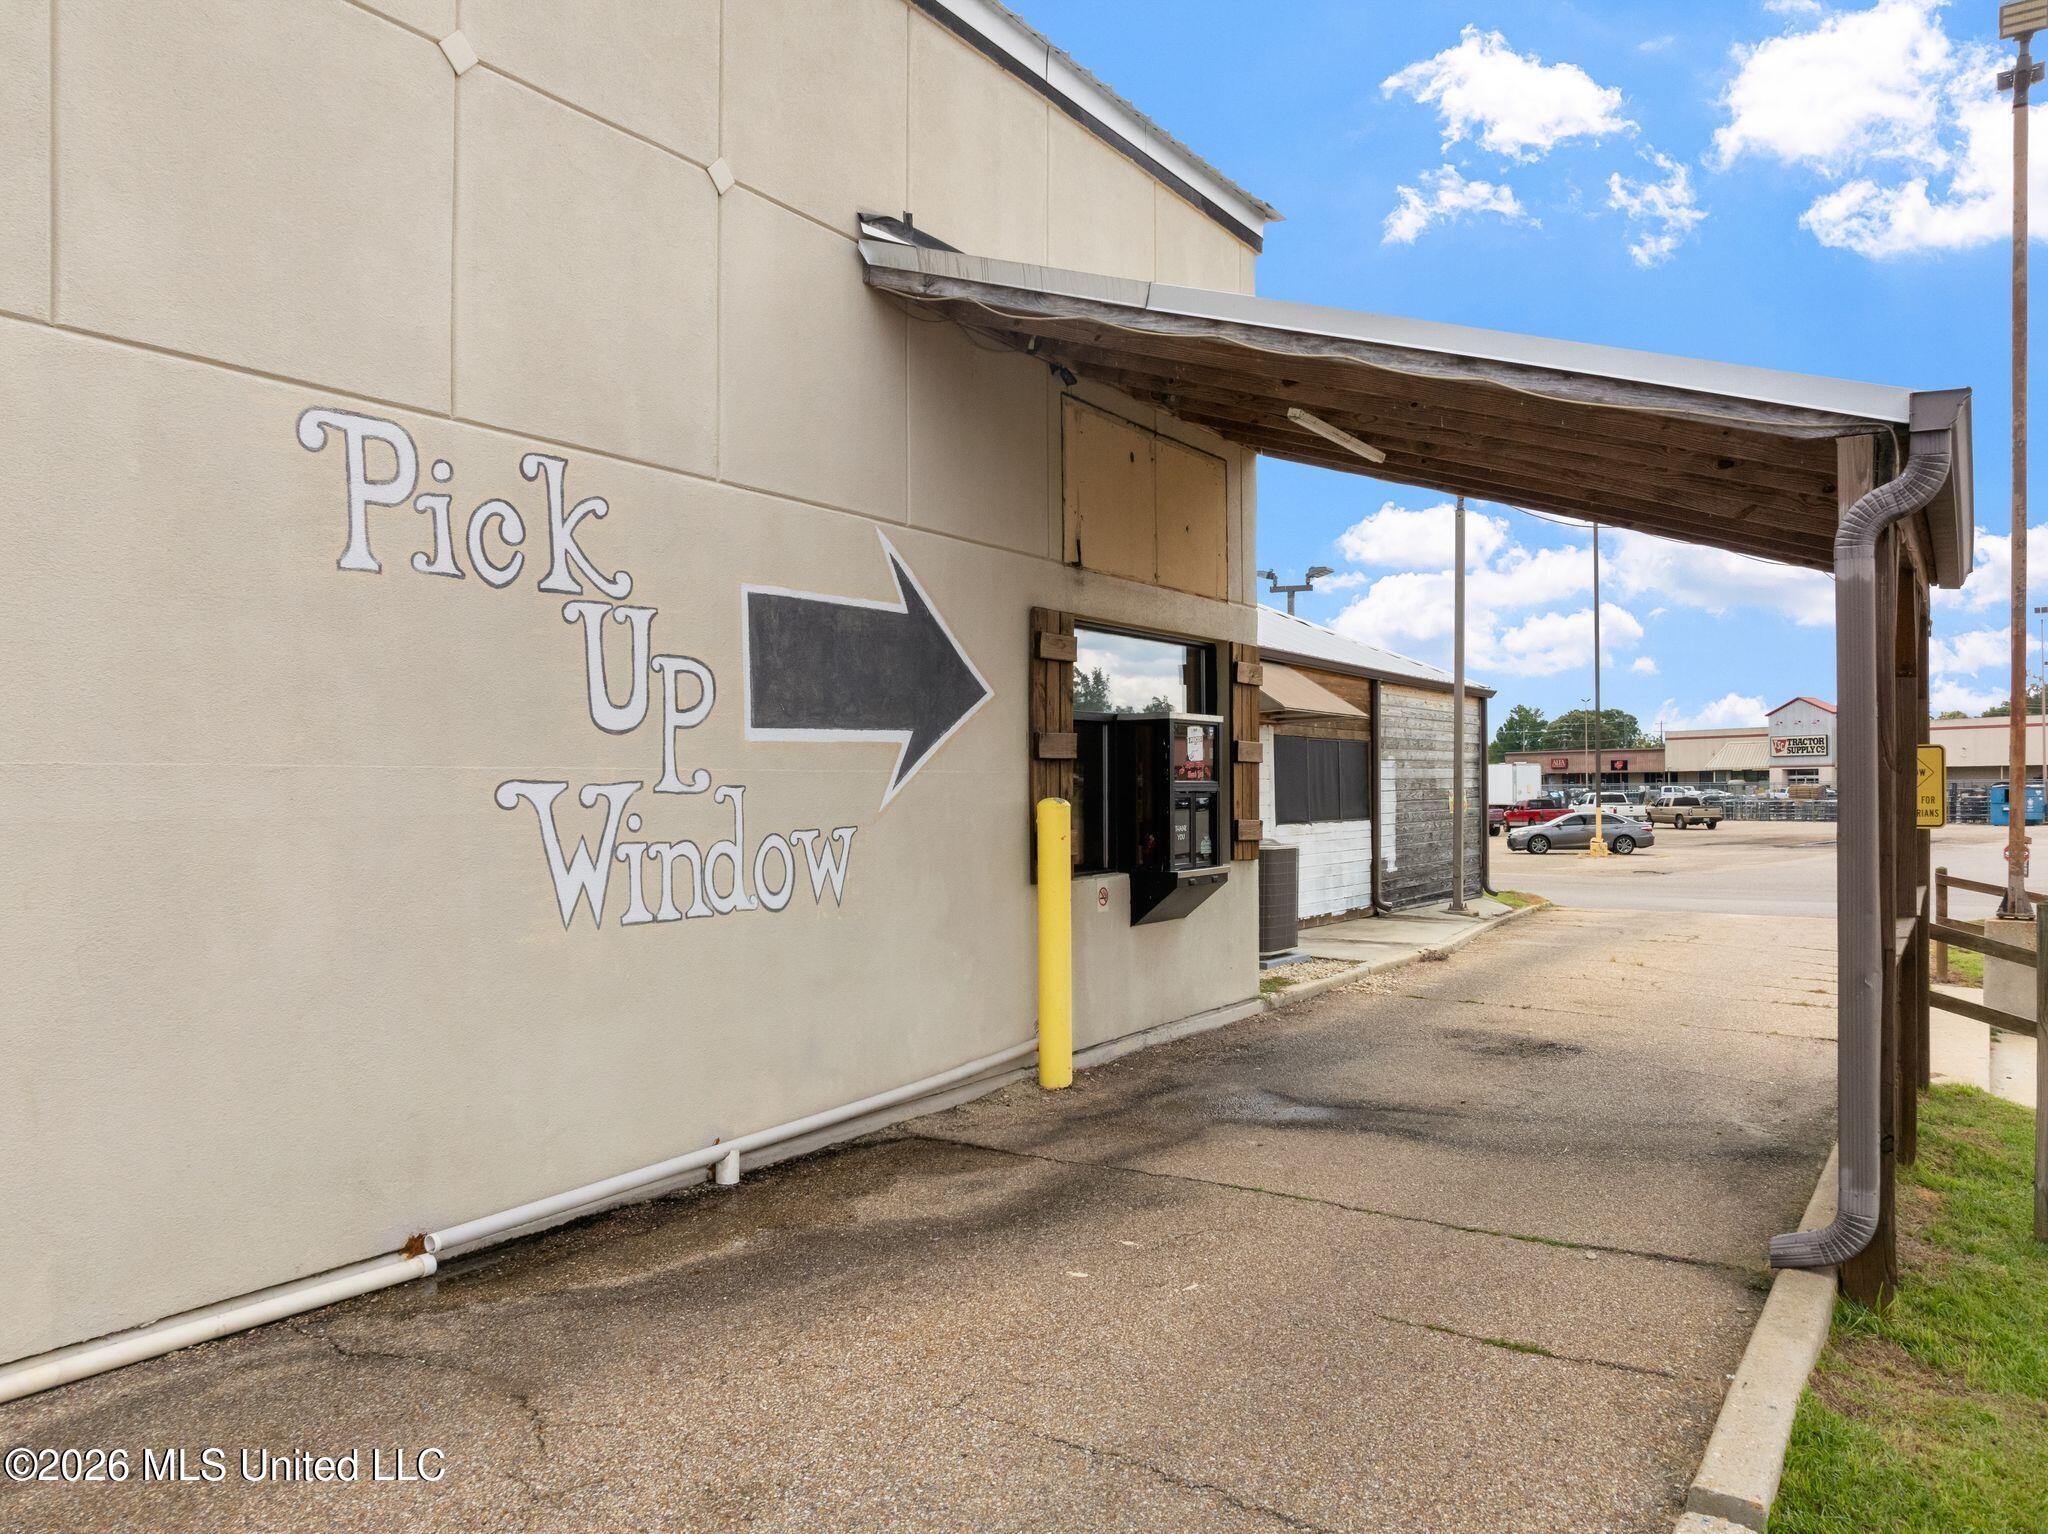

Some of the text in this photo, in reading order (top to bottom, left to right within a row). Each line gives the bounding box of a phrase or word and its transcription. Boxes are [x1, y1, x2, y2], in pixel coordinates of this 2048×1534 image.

[297, 406, 632, 600] Pick
[1787, 737, 1825, 746] TRACTOR
[1787, 746, 1815, 754] SUPPLY
[1921, 796, 1936, 805] FOR
[1176, 833, 1186, 841] YOU
[494, 780, 858, 931] Window
